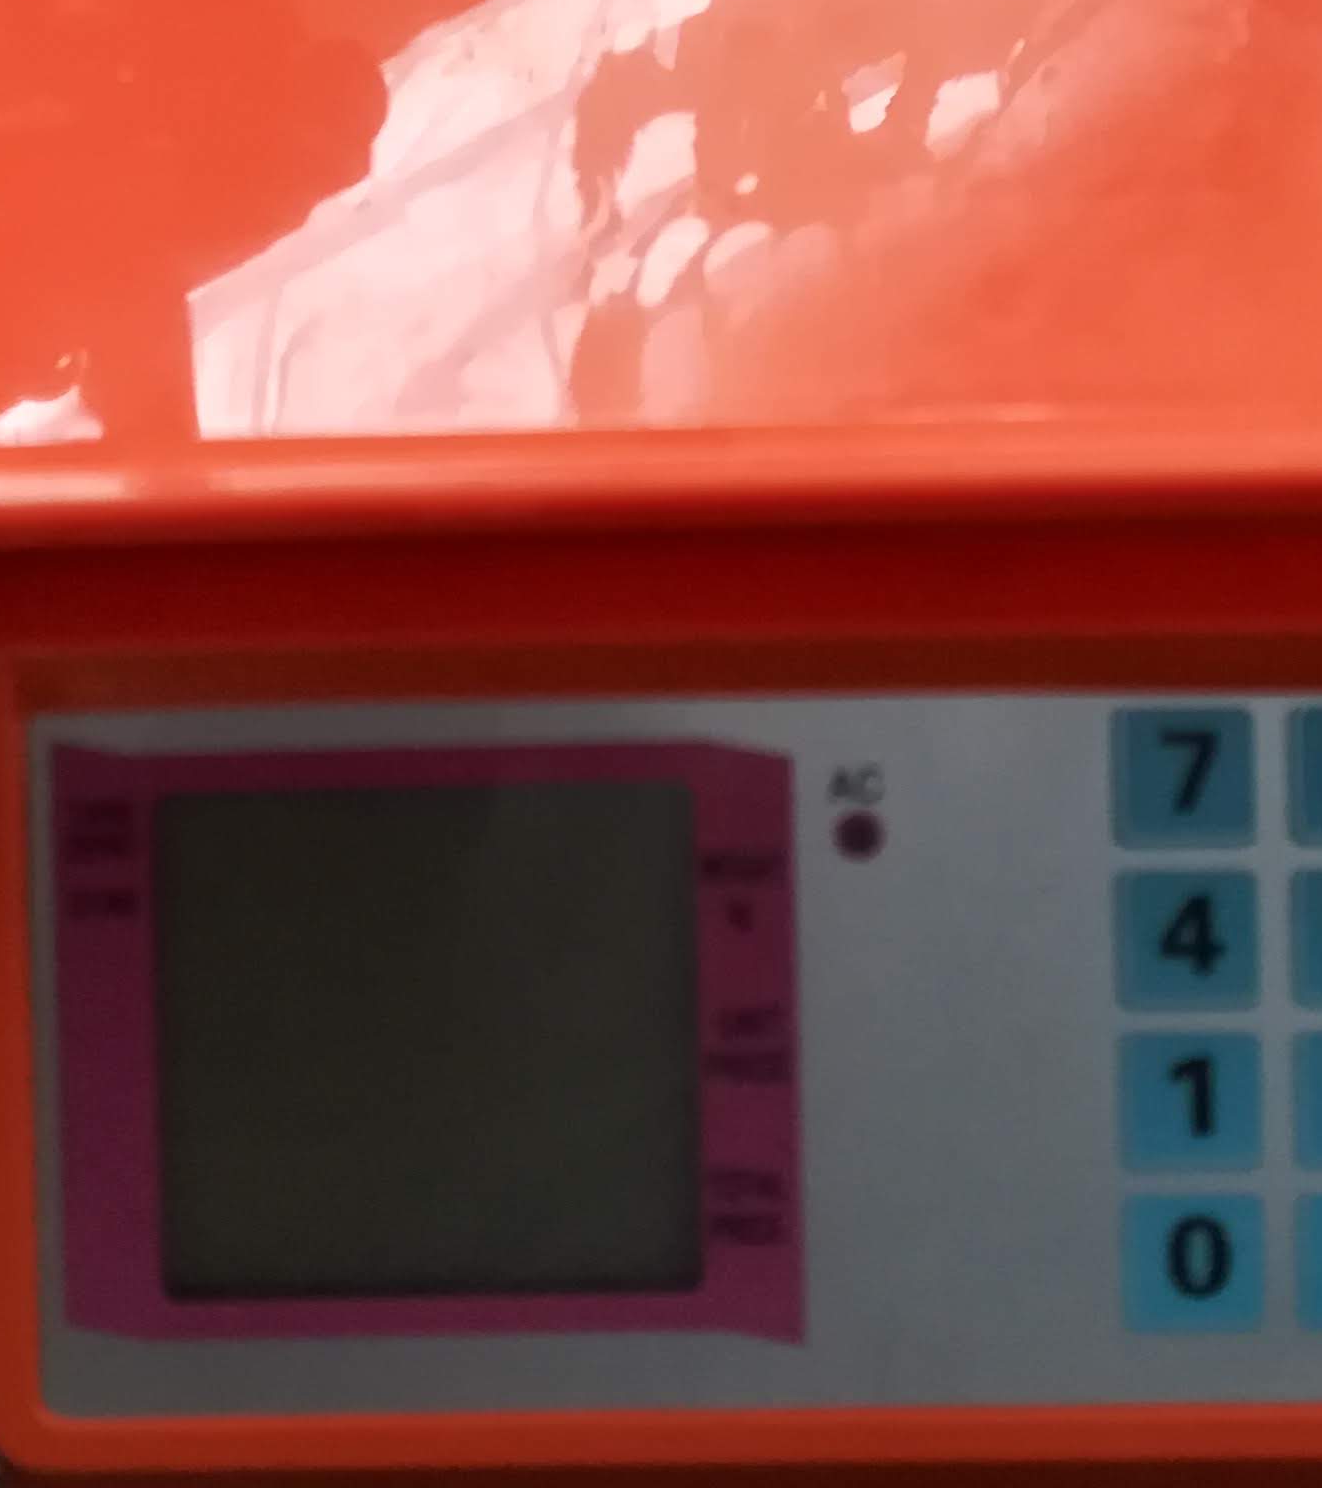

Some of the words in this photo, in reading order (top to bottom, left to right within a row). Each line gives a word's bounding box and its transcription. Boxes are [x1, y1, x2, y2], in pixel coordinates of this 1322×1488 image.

[1157, 725, 1222, 817] 7
[1155, 889, 1229, 977] 4
[1166, 1051, 1218, 1140] 1
[1163, 1211, 1236, 1303] 0
